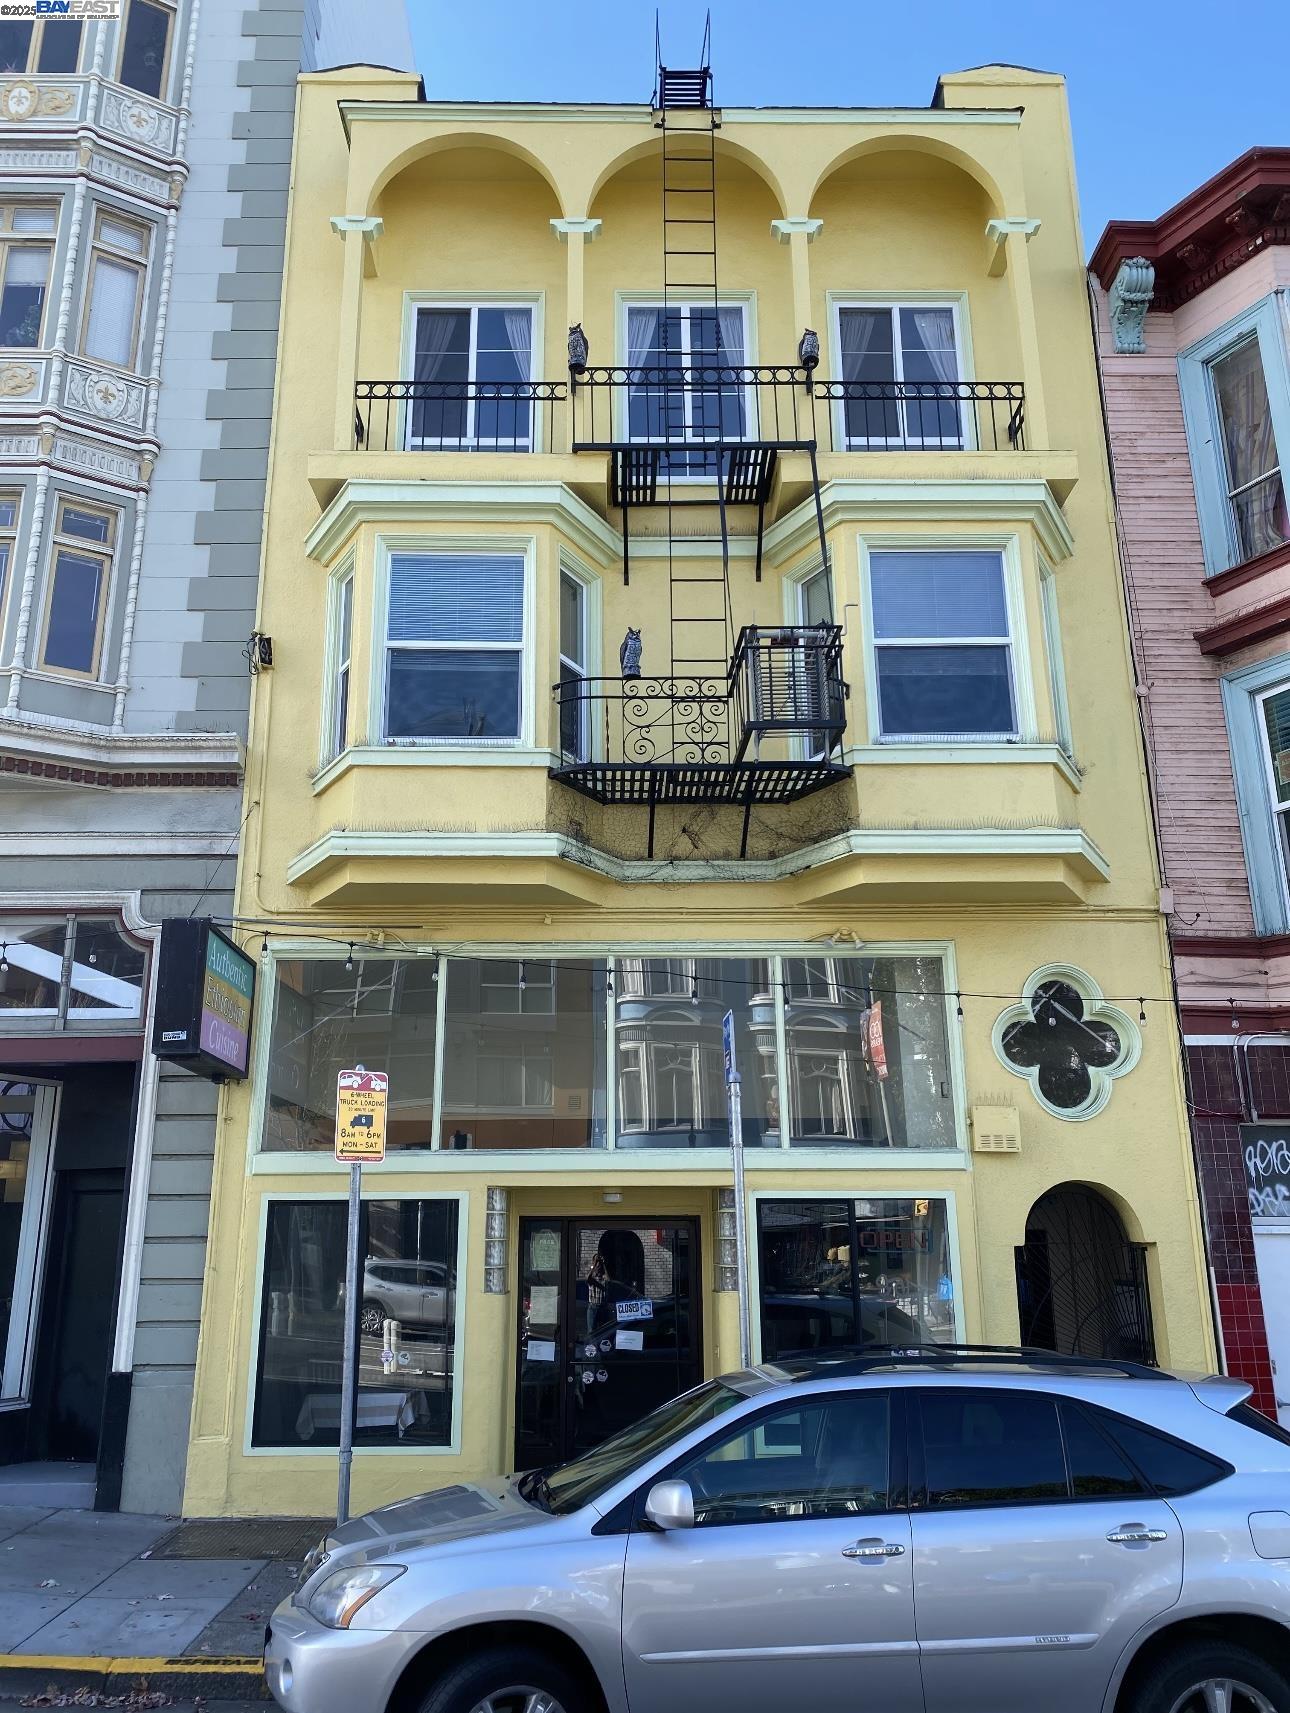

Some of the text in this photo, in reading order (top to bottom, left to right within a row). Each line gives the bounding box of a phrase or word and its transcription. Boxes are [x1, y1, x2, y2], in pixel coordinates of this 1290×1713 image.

[208, 939, 248, 992] Authentic
[204, 976, 246, 1028] Ethiopian
[208, 1020, 240, 1061] Cuisine
[361, 1116, 366, 1124] 6
[341, 1129, 355, 1138] 8AM
[367, 1130, 381, 1138] 6PM
[860, 1231, 927, 1249] OPEN
[618, 1302, 640, 1314] CLOSED
